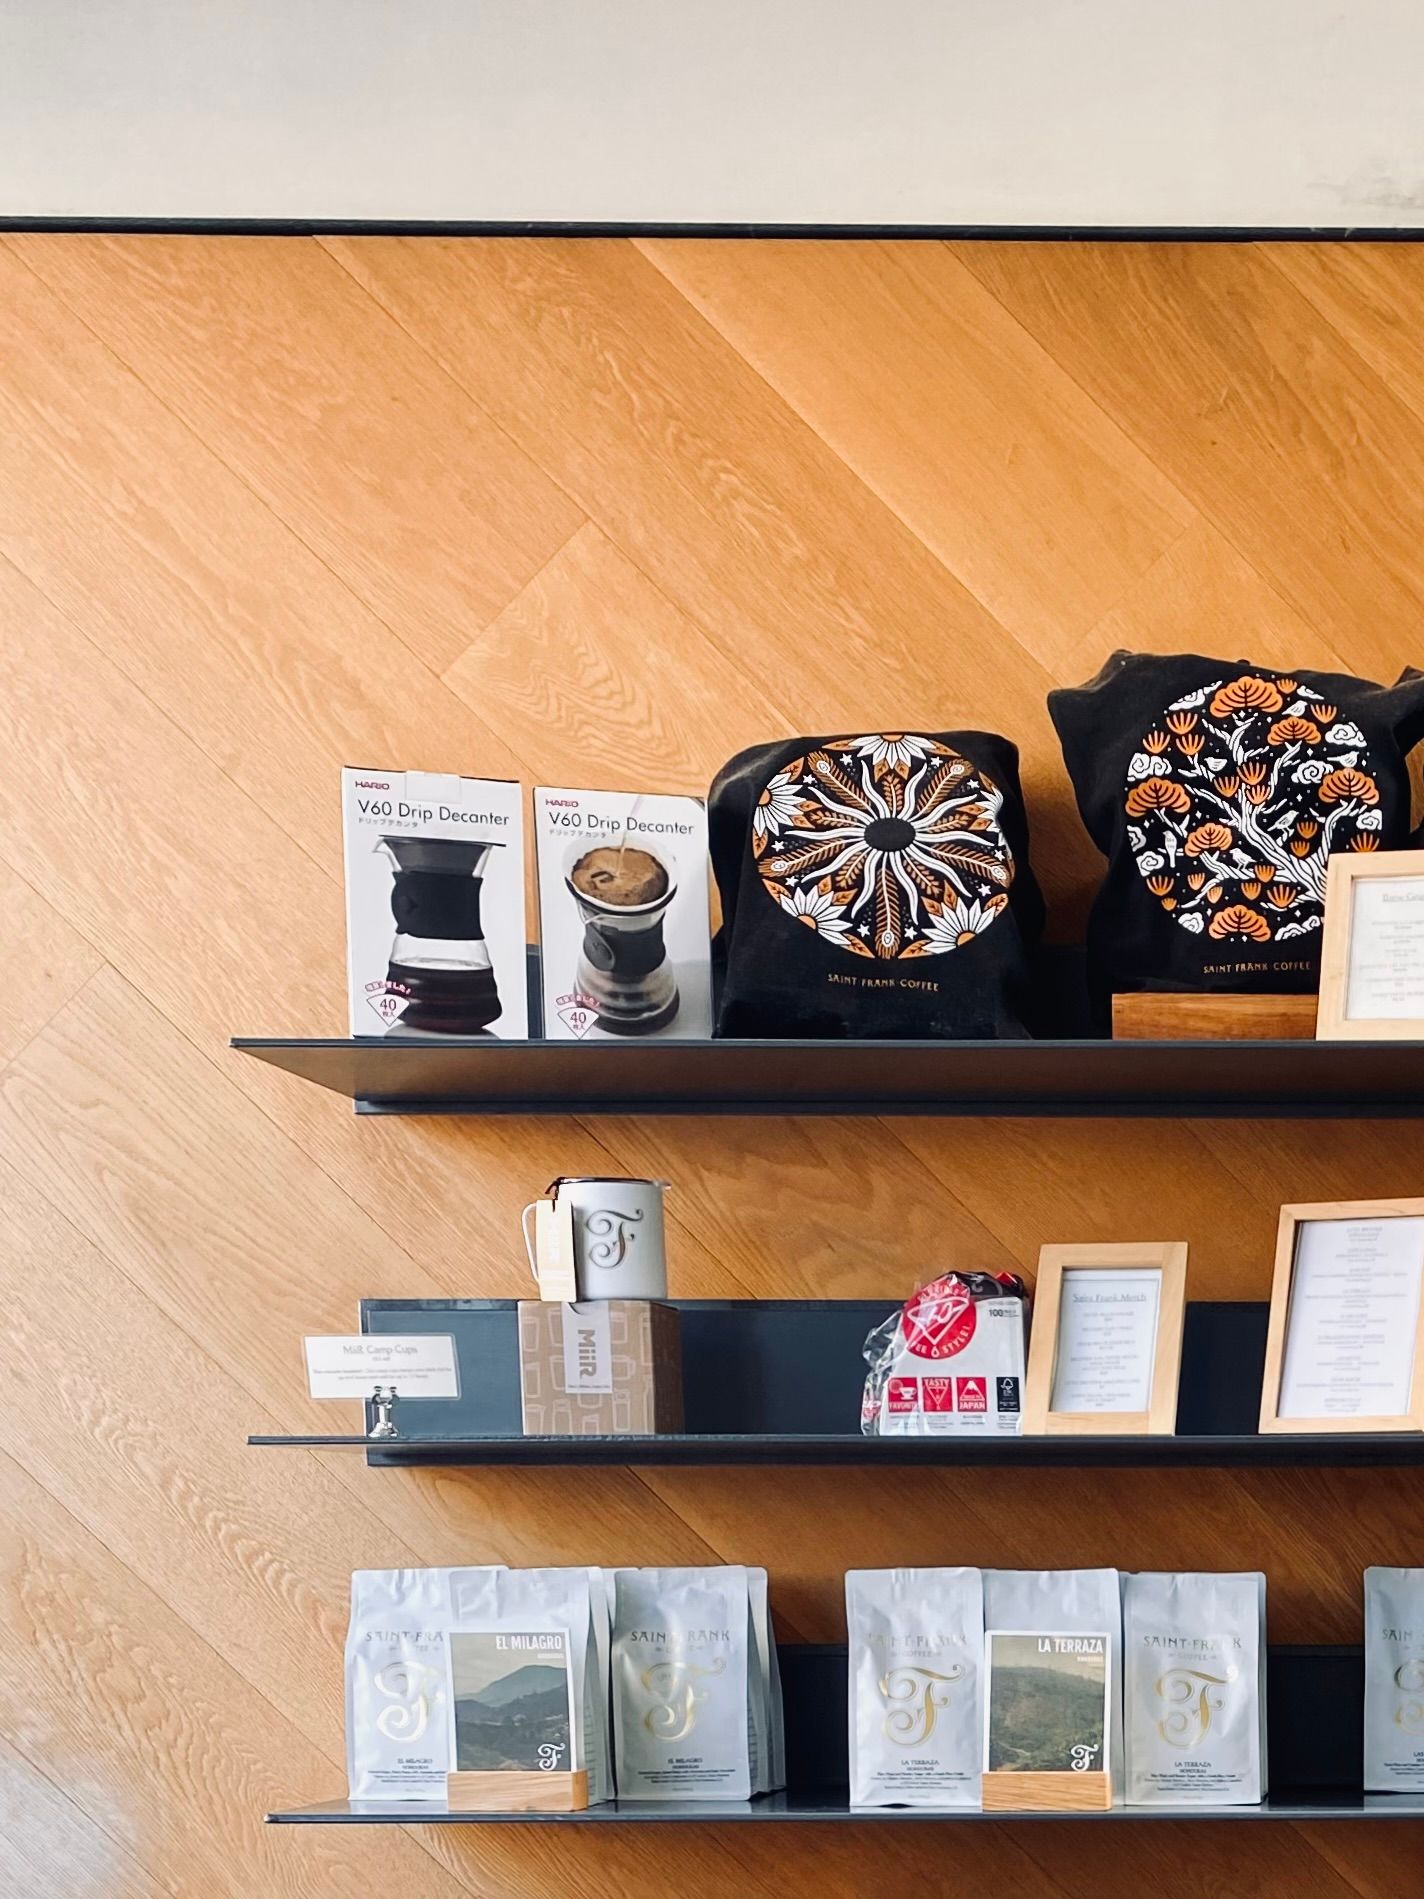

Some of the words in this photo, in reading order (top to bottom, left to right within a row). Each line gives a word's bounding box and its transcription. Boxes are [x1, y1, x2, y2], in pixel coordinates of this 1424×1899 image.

[355, 781, 390, 791] HARIO
[545, 798, 579, 808] HARIO
[358, 800, 392, 816] V60
[398, 802, 433, 823] Drip
[439, 806, 510, 826] Decanter
[549, 812, 582, 828] V60
[587, 814, 621, 834] Drip
[626, 817, 695, 835] Decanter
[1203, 963, 1231, 974] SAINT
[1235, 961, 1269, 972] FRANK
[1273, 960, 1312, 971] COFFEE
[827, 973, 857, 986] SAINT
[861, 977, 896, 988] FRANK
[899, 978, 940, 992] COFFEE
[380, 999, 397, 1011] 40
[569, 1011, 587, 1023] 40
[989, 1309, 1004, 1317] 100
[578, 1329, 597, 1379] MiiR
[959, 1402, 985, 1410] JAPAN
[496, 1636, 509, 1650] EL
[511, 1635, 563, 1650] MILAGRO
[1038, 1638, 1051, 1652] LA
[1054, 1639, 1104, 1653] TERRAZA
[1143, 1636, 1187, 1648] SAINT
